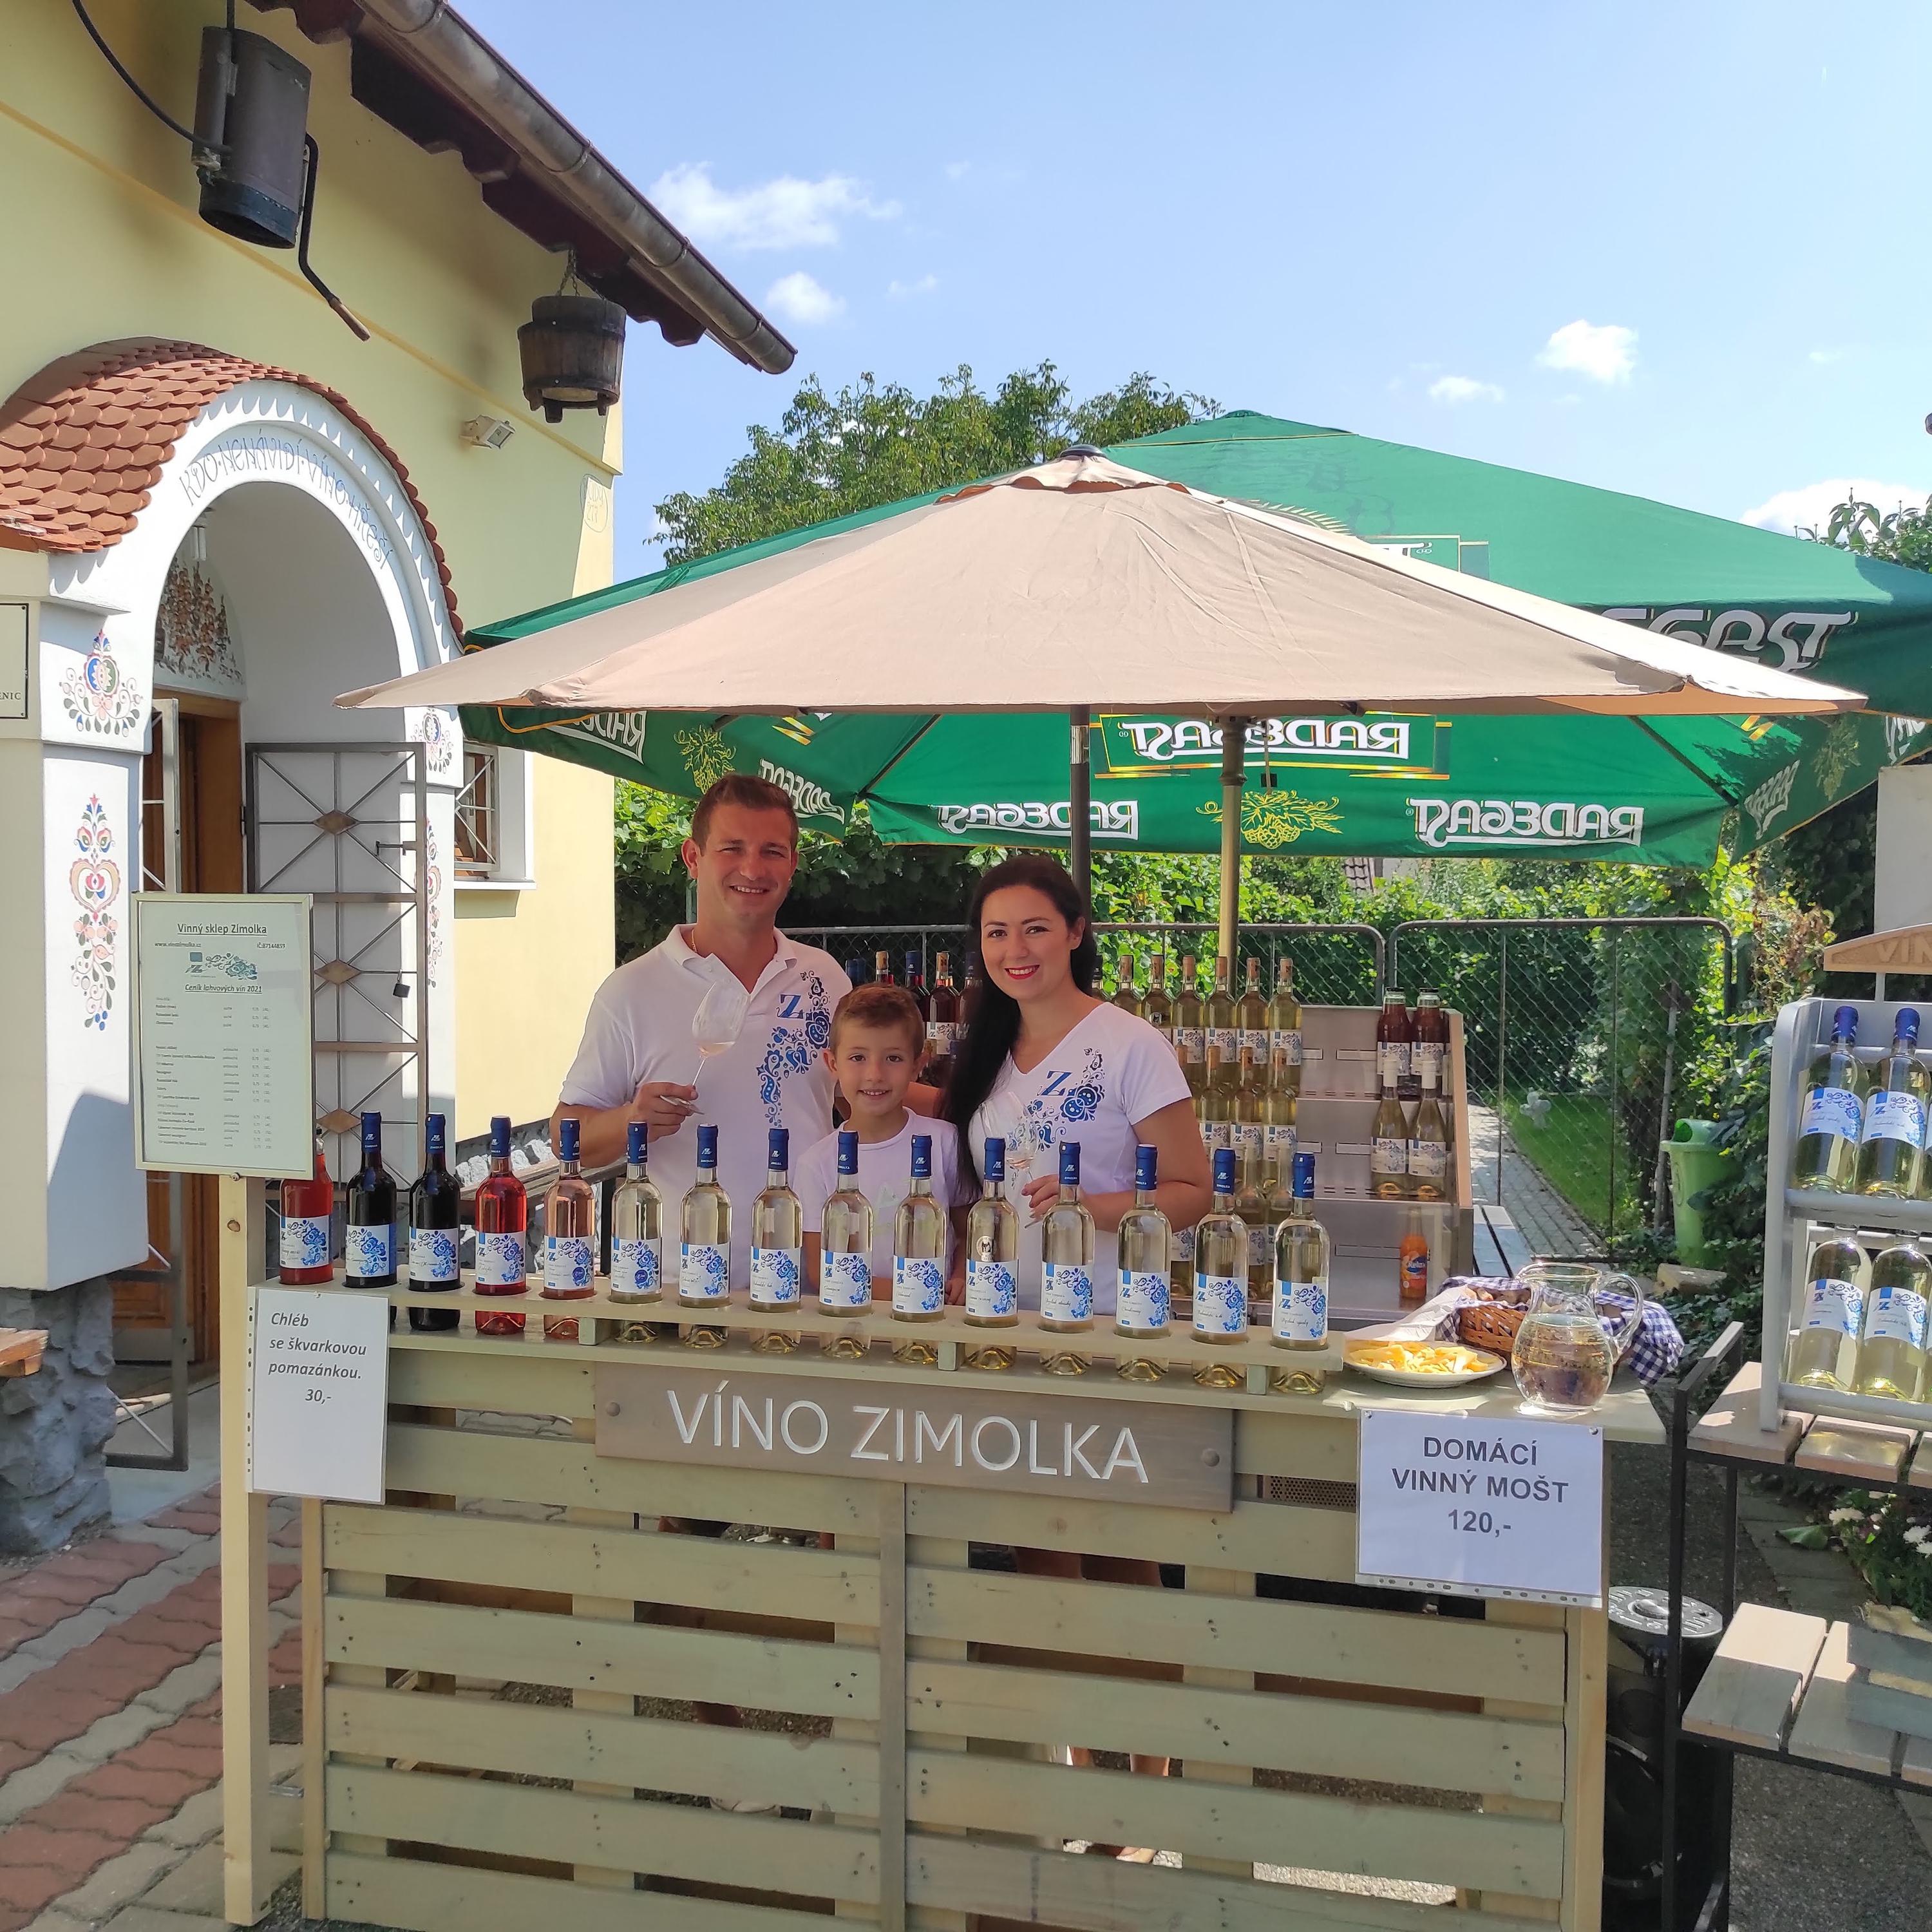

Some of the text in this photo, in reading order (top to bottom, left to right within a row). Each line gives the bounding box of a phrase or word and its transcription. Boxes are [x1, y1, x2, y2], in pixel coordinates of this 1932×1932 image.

[177, 923, 203, 934] Vinný
[205, 923, 229, 935] sklep
[270, 1312, 310, 1327] Chléb
[269, 1336, 367, 1356] se škvarkovou
[268, 1363, 362, 1379] pomazánkou.
[305, 1388, 332, 1405] 30,-
[667, 1379, 1149, 1484] VÍNO ZIMOLKA
[1423, 1437, 1538, 1466] DOMÁCÍ
[1391, 1468, 1569, 1503] VINNÝ MOŠT
[1448, 1509, 1512, 1539] 120,-
